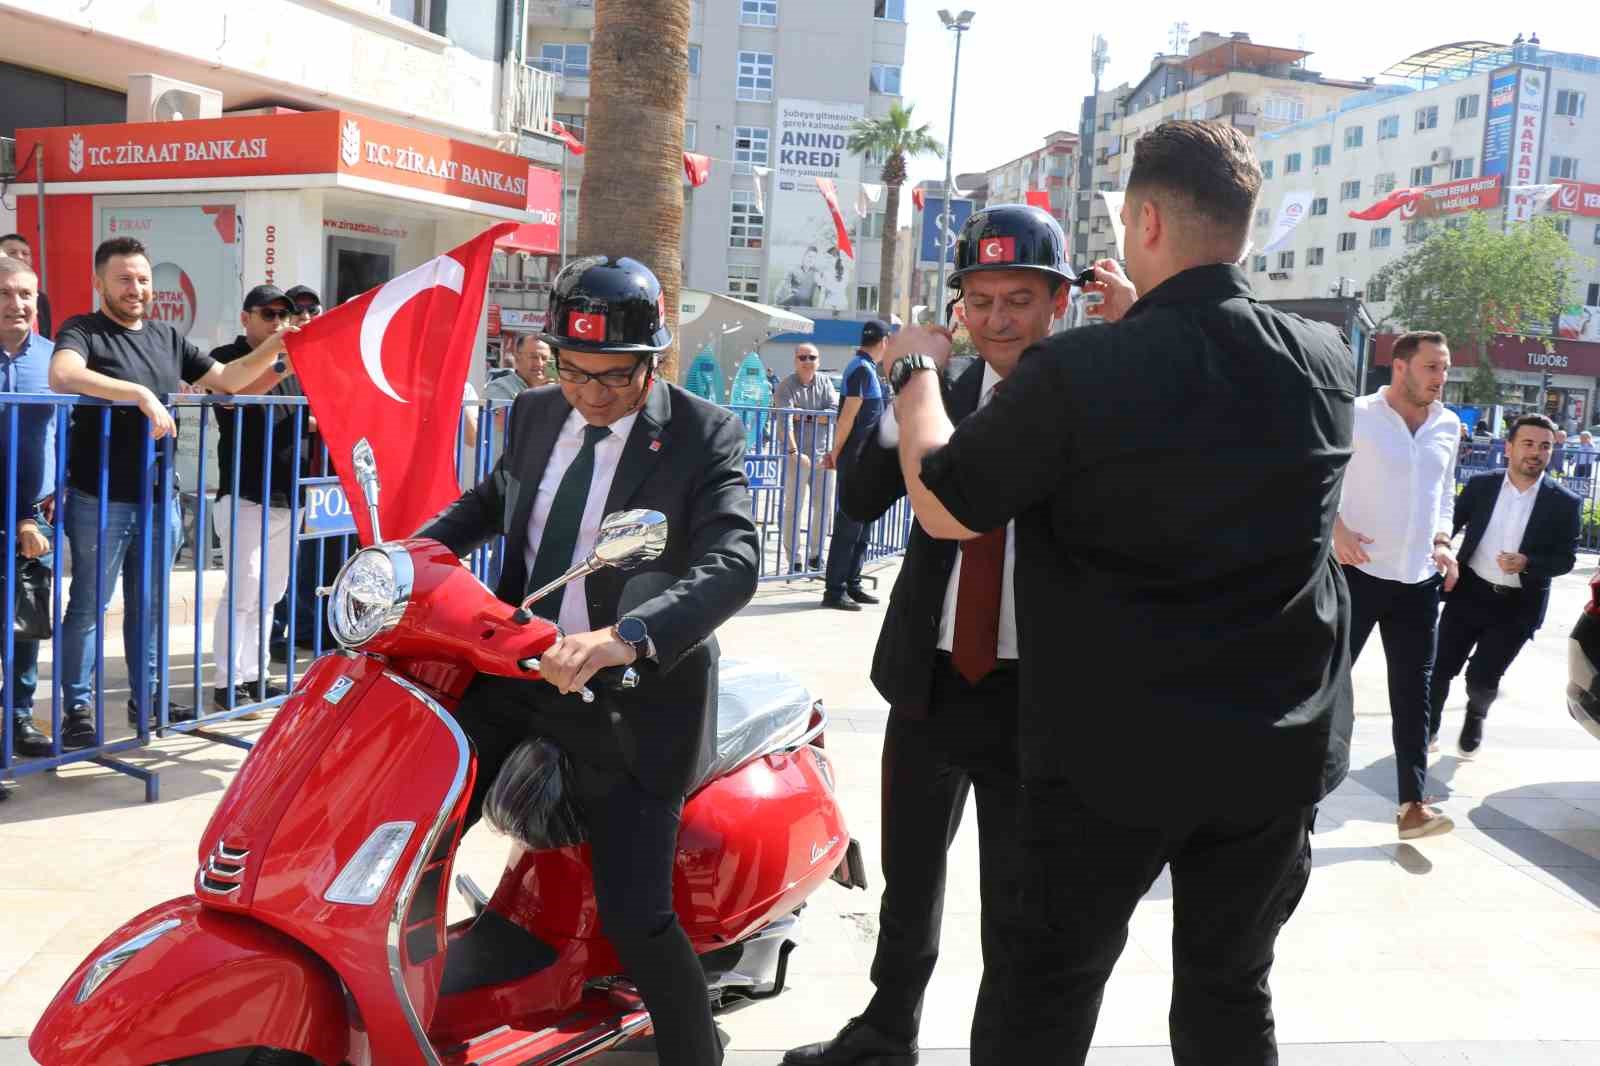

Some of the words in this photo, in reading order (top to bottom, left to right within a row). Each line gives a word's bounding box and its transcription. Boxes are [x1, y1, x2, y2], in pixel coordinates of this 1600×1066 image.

[116, 141, 181, 164] ZİRAAT
[184, 138, 268, 161] BANKASI
[395, 146, 459, 180] ZİRAAT
[461, 164, 527, 196] BANKASI
[144, 303, 185, 321] ATM
[1528, 352, 1568, 367] TUDORS
